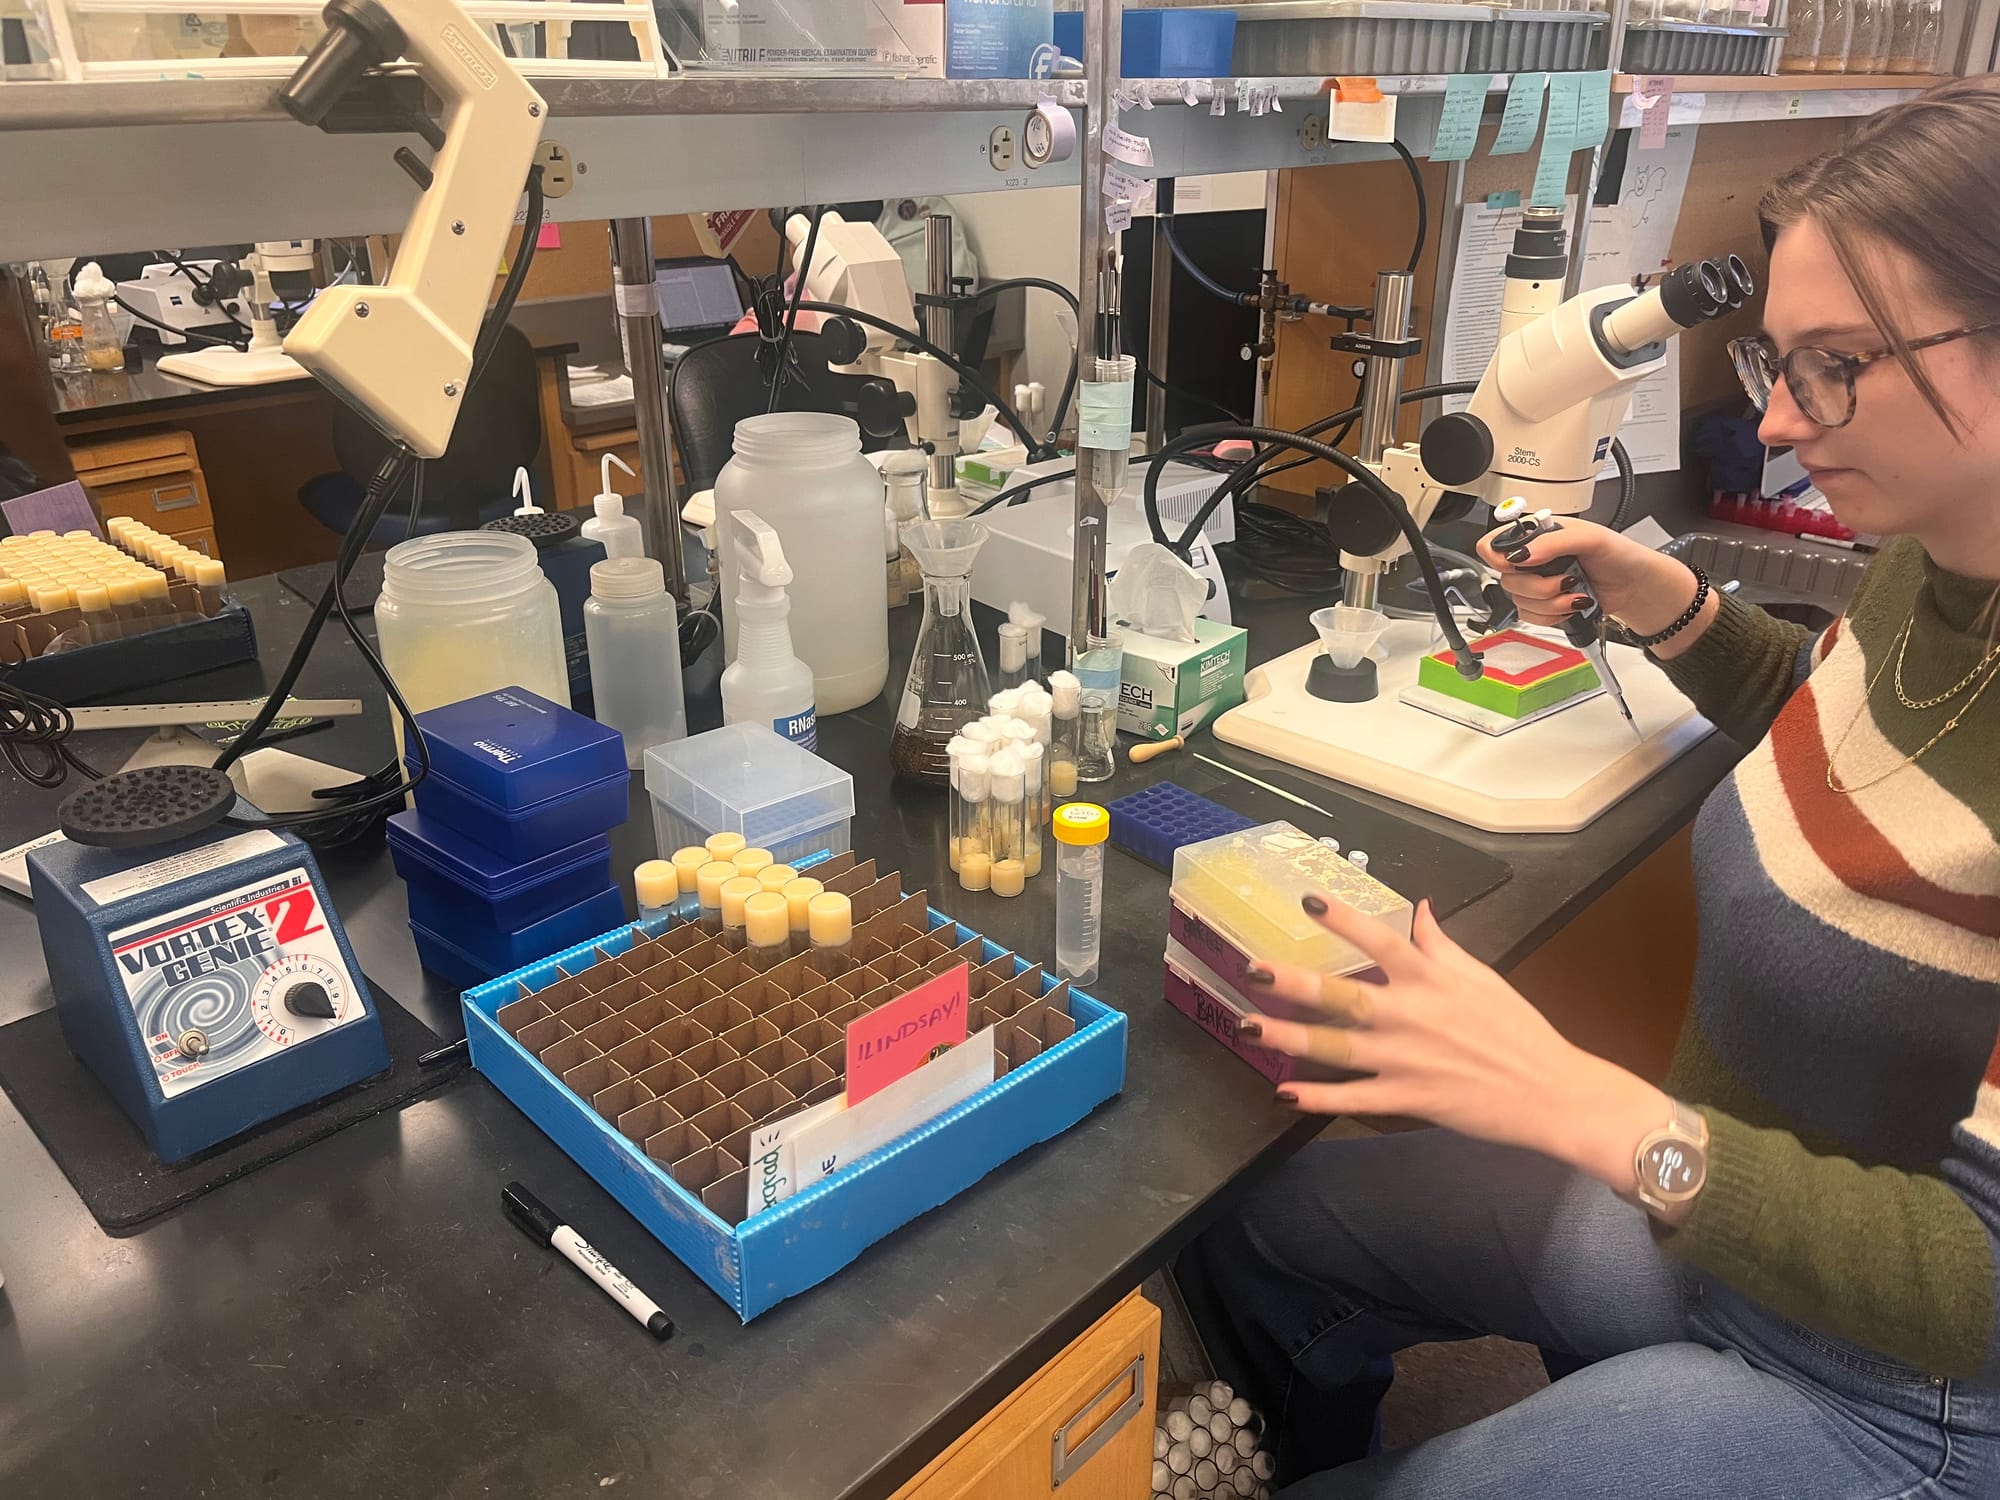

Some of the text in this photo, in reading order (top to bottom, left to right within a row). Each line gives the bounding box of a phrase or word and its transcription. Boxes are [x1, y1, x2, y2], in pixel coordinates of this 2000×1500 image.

[1507, 454, 1541, 467] 2000-CS
[1514, 447, 1536, 458] Stemi
[953, 653, 966, 661] 500
[1201, 650, 1231, 672] KIMTECH
[954, 698, 967, 706] 400
[1121, 682, 1153, 702] ECH
[788, 713, 816, 736] RNas
[473, 740, 516, 764] Thermo
[210, 896, 247, 914] Scientific
[247, 883, 286, 904] Industries
[265, 889, 325, 946] 2
[161, 929, 275, 988] GENIE
[155, 1032, 168, 1042] ON
[170, 1061, 201, 1078] TOUCH
